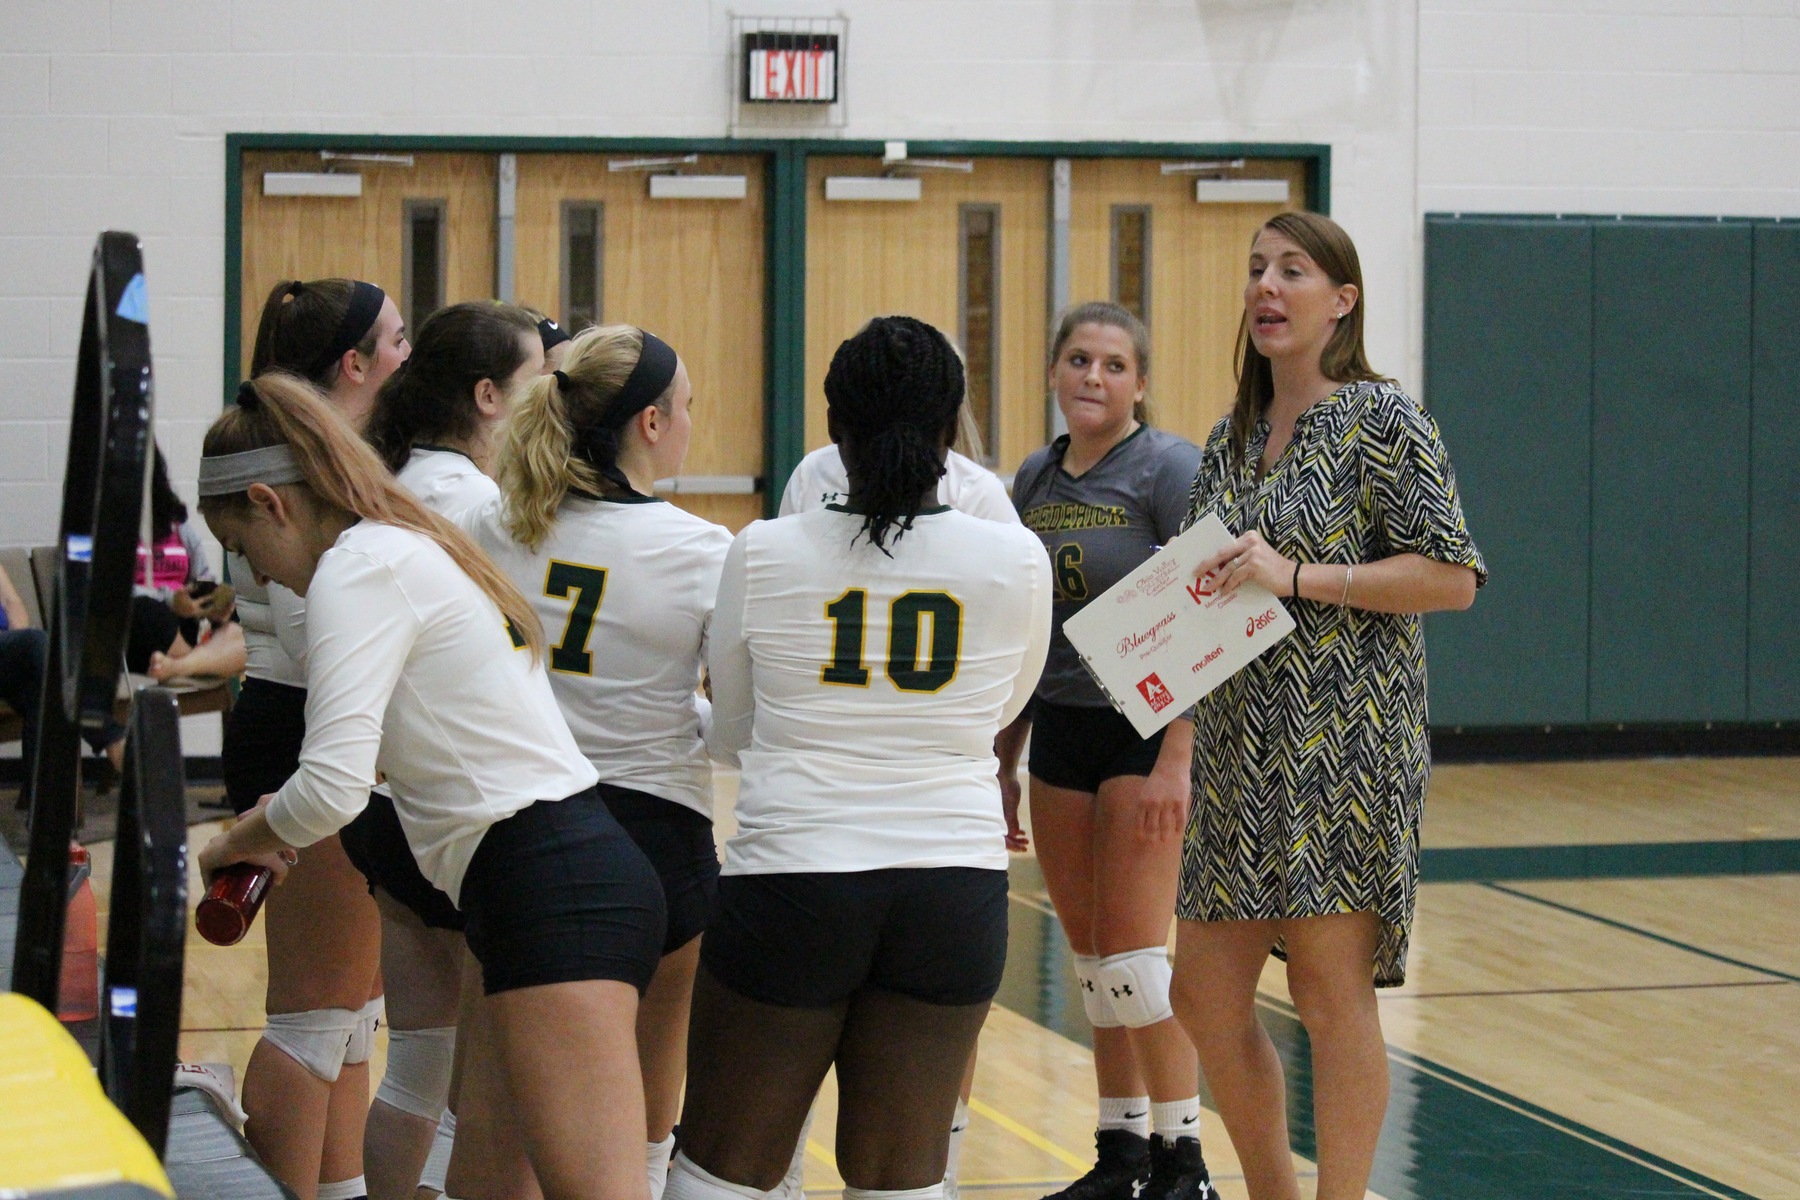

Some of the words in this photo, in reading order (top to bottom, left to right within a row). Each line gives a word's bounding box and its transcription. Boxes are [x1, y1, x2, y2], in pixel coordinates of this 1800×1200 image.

[765, 49, 824, 99] EXIT
[542, 558, 609, 676] 7
[819, 587, 964, 694] 10
[1116, 611, 1176, 658] Bluegrass
[1191, 646, 1224, 674] molten
